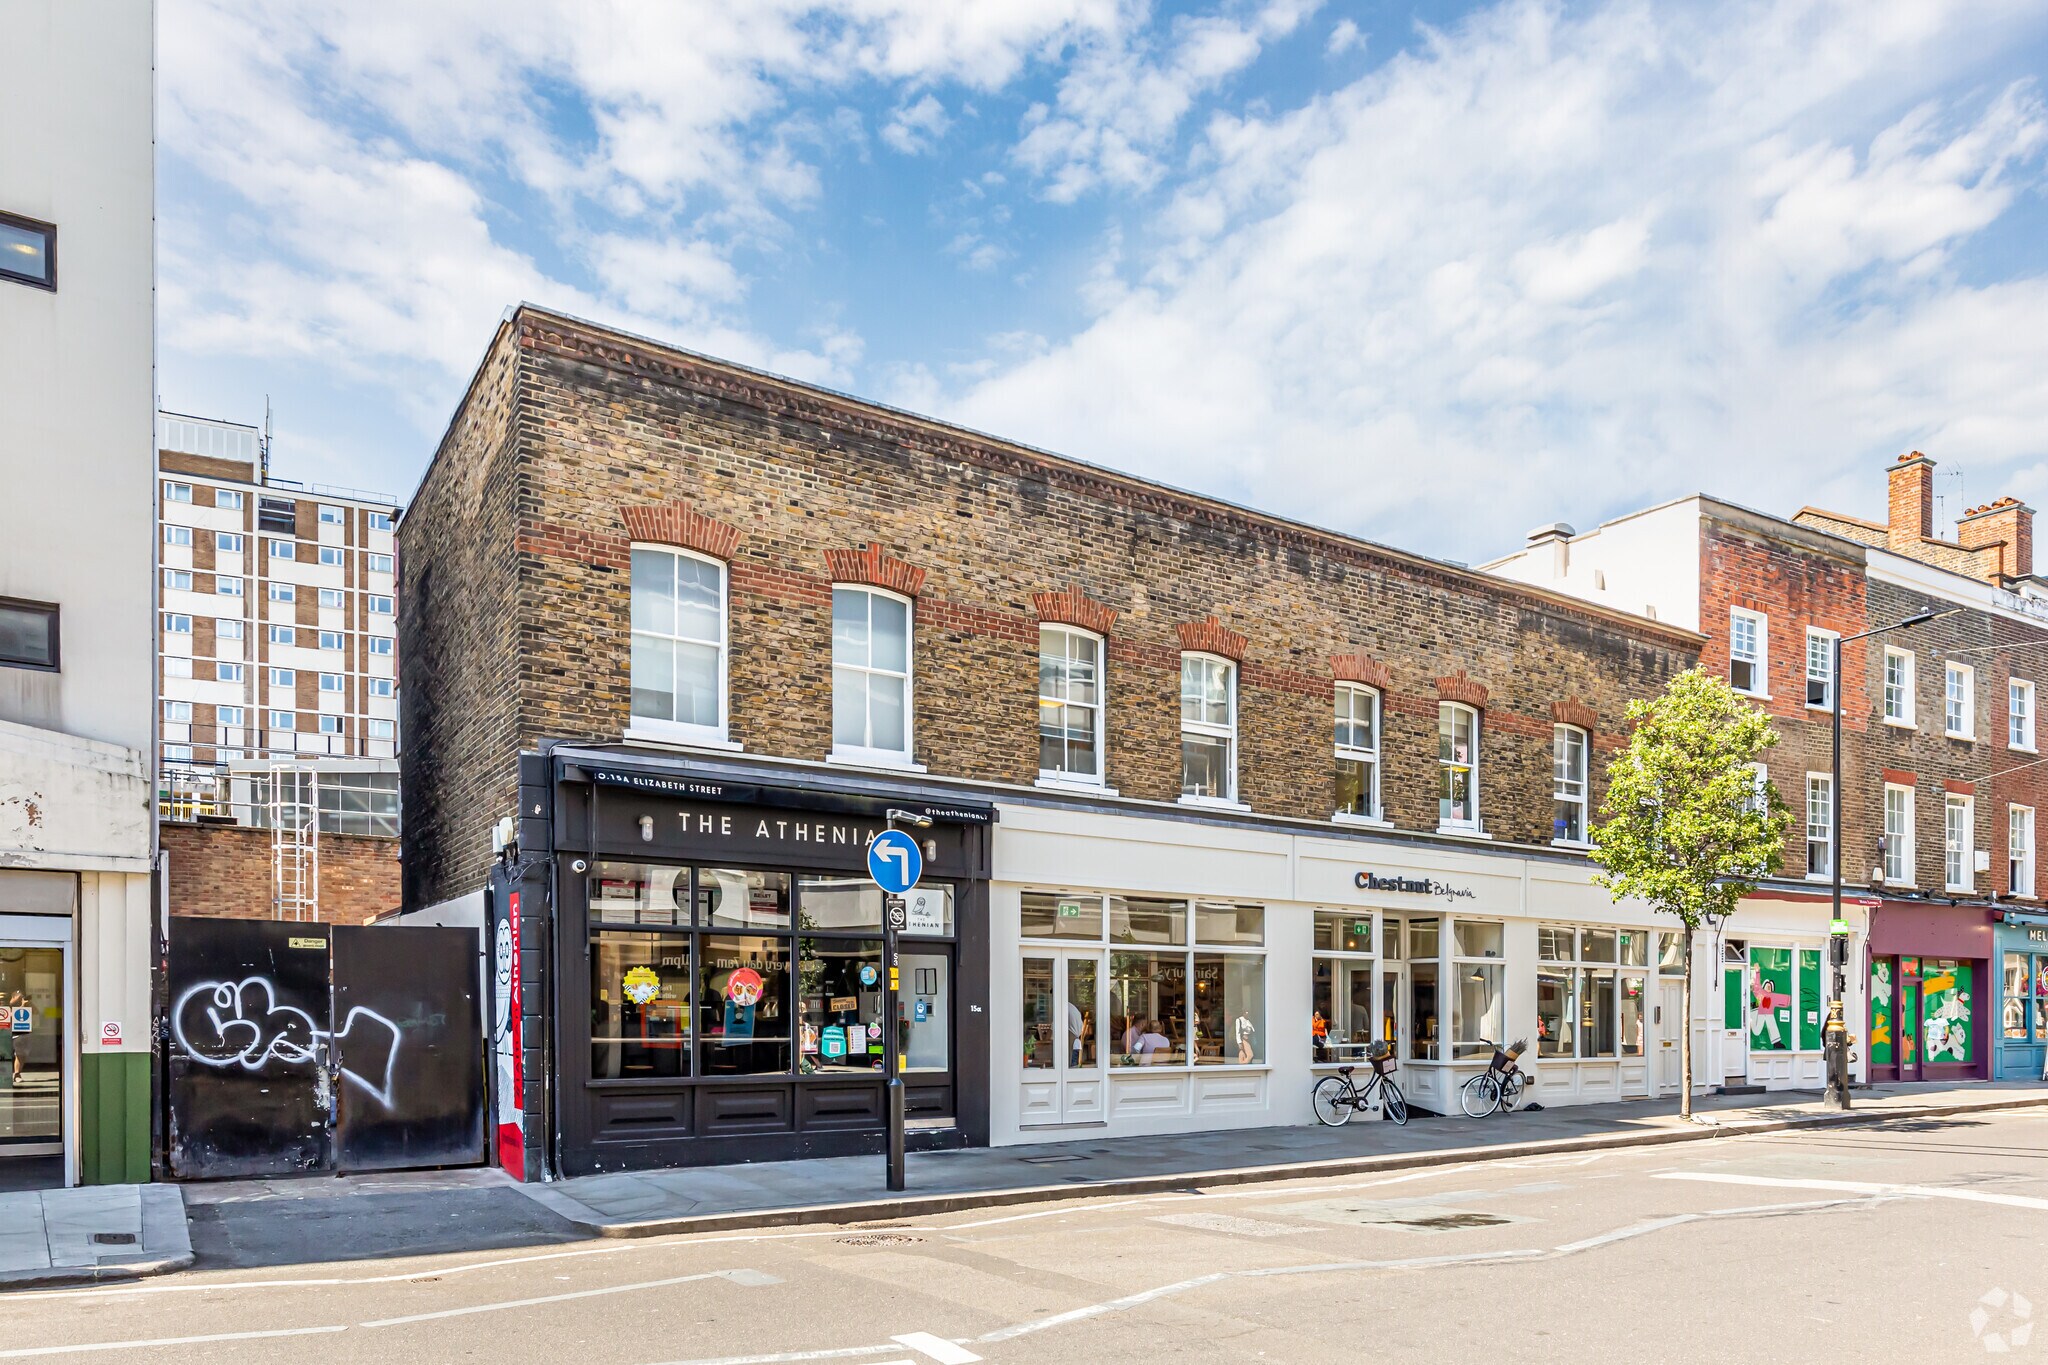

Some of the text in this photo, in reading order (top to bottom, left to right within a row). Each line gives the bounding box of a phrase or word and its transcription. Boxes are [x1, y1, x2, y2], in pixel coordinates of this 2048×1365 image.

[594, 772, 722, 795] O.15A ELIZABETH STREET
[678, 812, 875, 847] THE ATHENIA
[1355, 872, 1477, 902] Chestnut Belgravia
[2029, 930, 2048, 942] MEL
